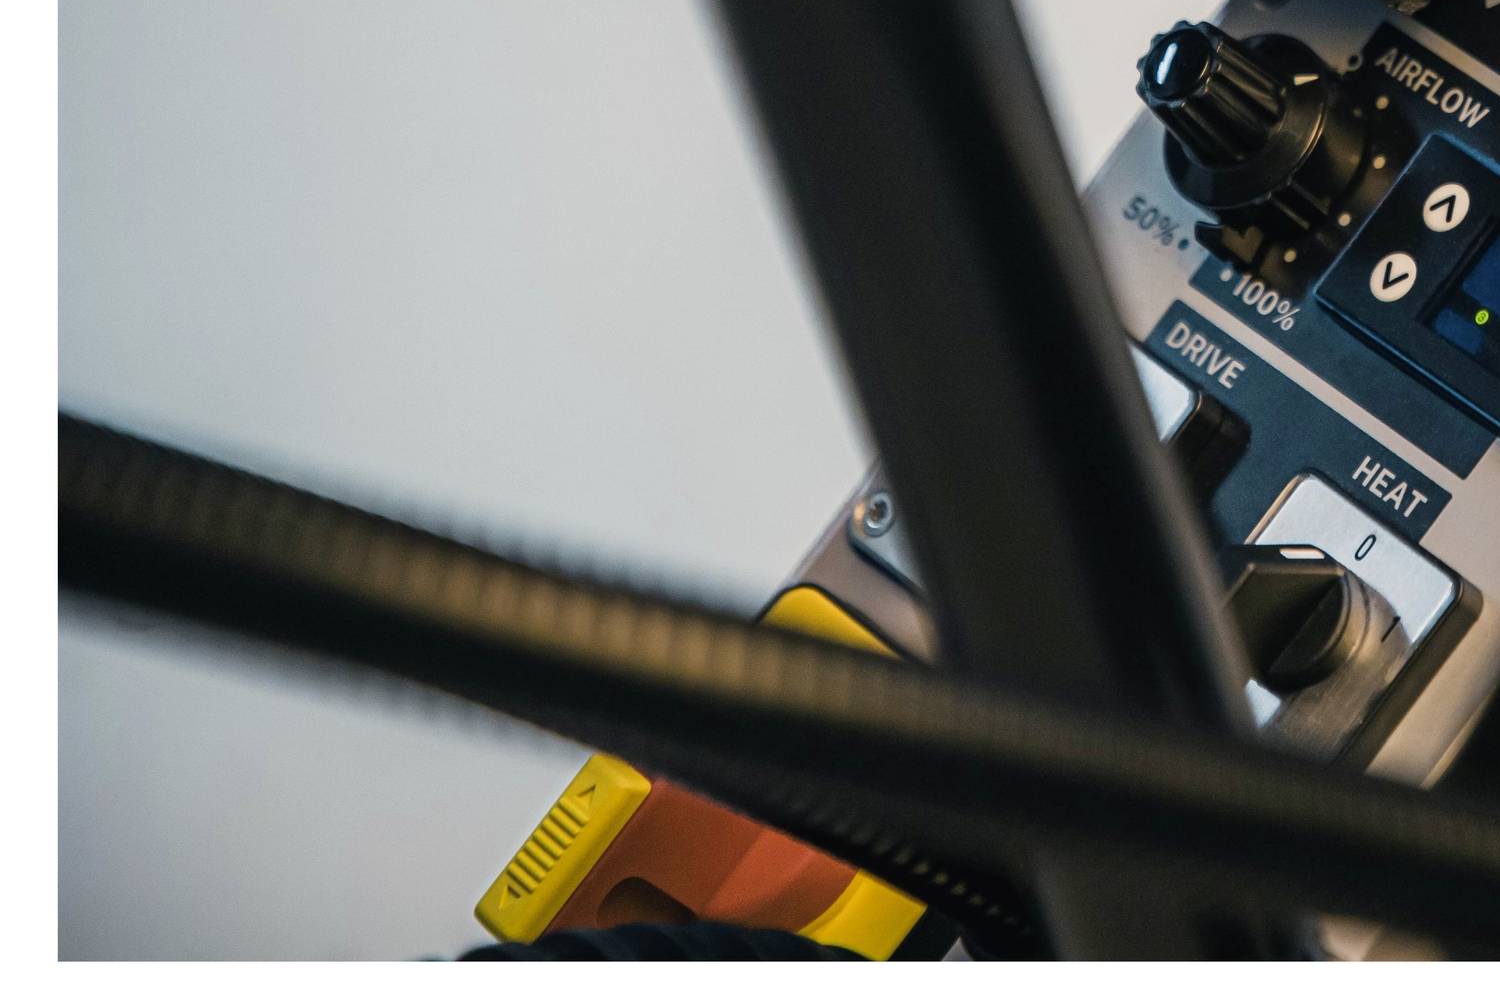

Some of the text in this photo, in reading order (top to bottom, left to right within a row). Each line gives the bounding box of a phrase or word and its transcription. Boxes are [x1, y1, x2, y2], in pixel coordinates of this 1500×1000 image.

[1376, 47, 1489, 128] AIRFLOW
[1123, 197, 1179, 246] 50%
[1232, 274, 1300, 331] 100%
[1165, 322, 1246, 389] DRIVE
[1352, 456, 1428, 518] HEAT
